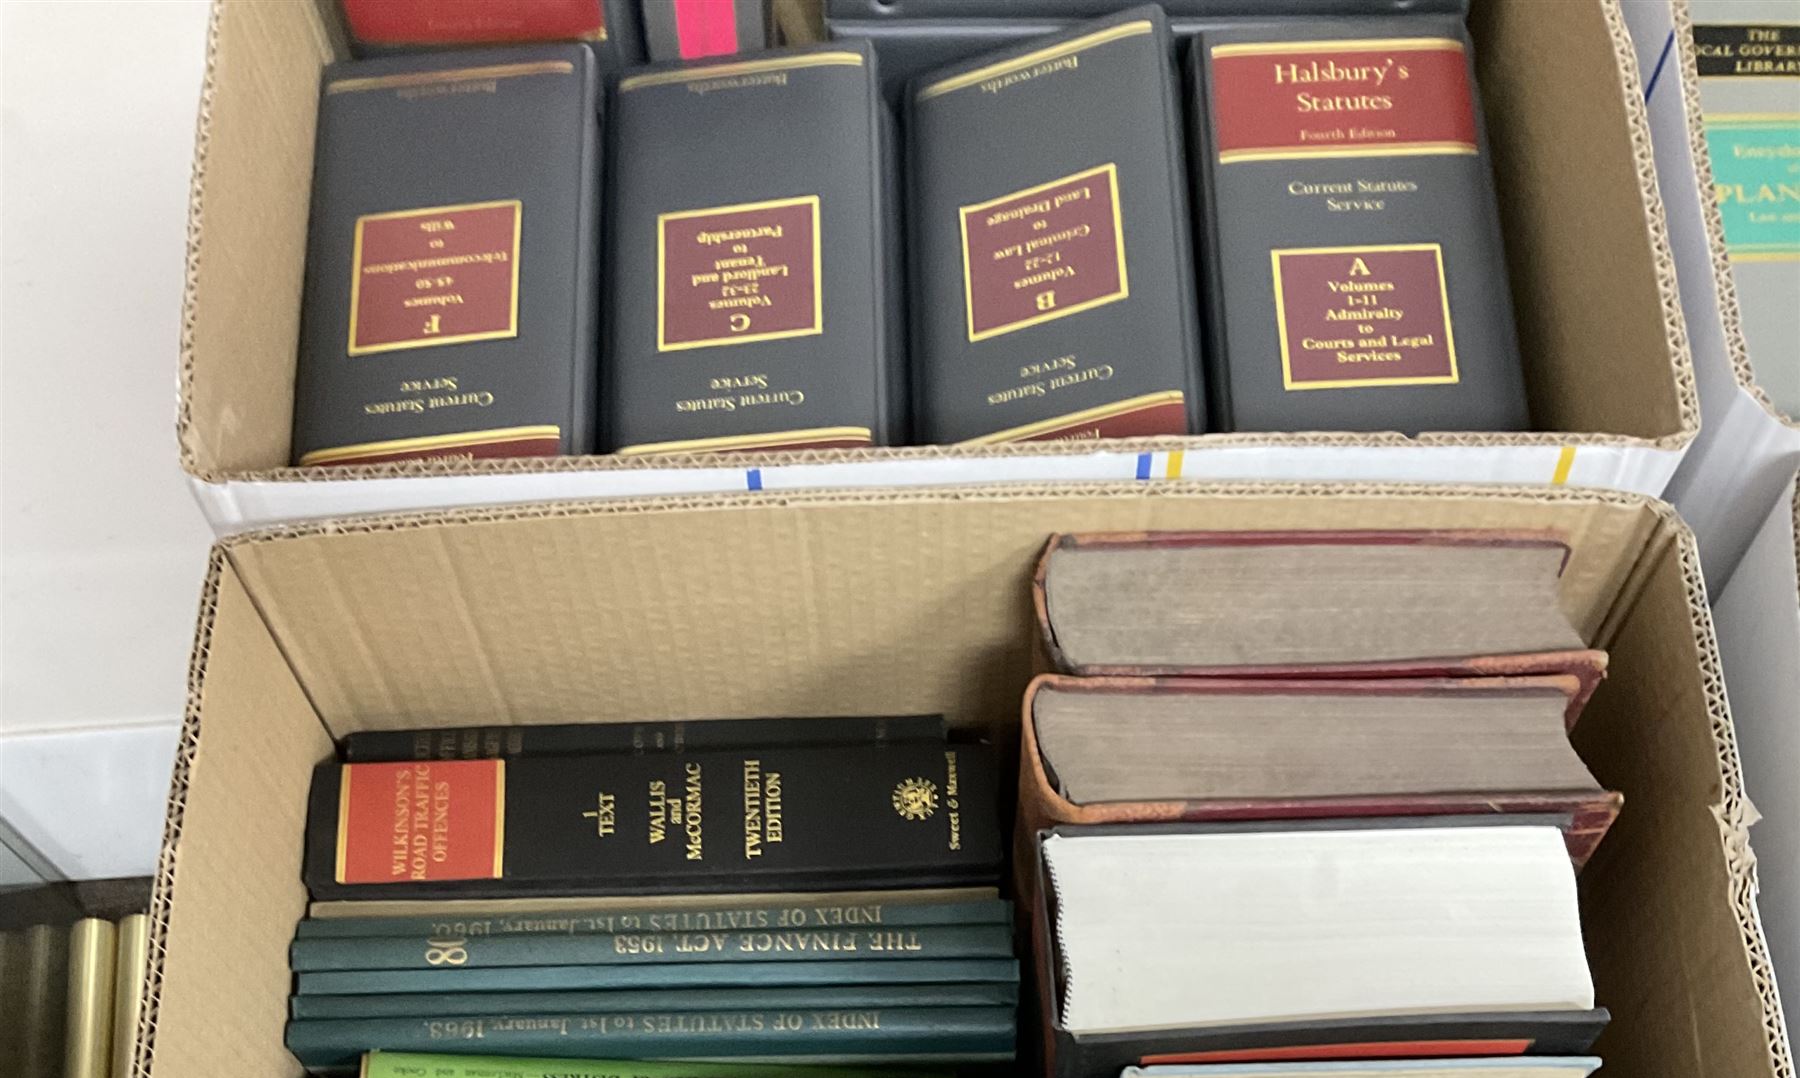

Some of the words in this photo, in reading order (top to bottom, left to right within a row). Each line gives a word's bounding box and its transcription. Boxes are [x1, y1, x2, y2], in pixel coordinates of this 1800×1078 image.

[1739, 44, 1800, 57] GOVER
[1274, 58, 1410, 83] Halsbury's
[1296, 91, 1393, 113] Statutes
[1300, 128, 1343, 142] Fourth
[1348, 126, 1396, 140] Edition
[1288, 180, 1352, 196] Current
[1357, 178, 1417, 194] Statutes
[1052, 186, 1092, 210] Land
[1327, 197, 1386, 213] Service
[986, 199, 1049, 227] Drainage
[696, 224, 783, 245] Partnership
[1032, 220, 1048, 231] to
[1026, 223, 1091, 251] Criminal
[732, 243, 748, 254] to
[993, 246, 1024, 261] Law
[363, 250, 508, 277] Telecommunications
[715, 254, 766, 271] Tenant
[1348, 257, 1372, 277] A
[691, 273, 719, 288] and
[721, 264, 789, 287] Landlord
[1013, 265, 1076, 289] Volumes
[1327, 279, 1395, 294] Volumes
[404, 293, 464, 309] Volumes
[708, 295, 772, 311] Volumes
[1036, 289, 1056, 310] B
[423, 314, 441, 335] F
[730, 314, 751, 332] C
[1324, 307, 1405, 323] Admiralty
[1357, 322, 1375, 335] to
[1302, 336, 1354, 350] Courts
[1357, 335, 1388, 349] and
[1390, 334, 1434, 350] Legal
[1019, 354, 1076, 378] Service
[1336, 349, 1402, 364] Services
[400, 377, 458, 393] Service
[710, 374, 768, 390] Service
[1049, 364, 1114, 394] Current
[428, 391, 494, 411] Current
[740, 389, 805, 409] Current
[987, 382, 1047, 406] Statutes
[365, 398, 425, 415] Statutes
[675, 397, 736, 415] Statutes
[414, 764, 431, 832] TRAFFIC
[766, 772, 783, 843] EDITION
[598, 792, 615, 838] TEXT
[649, 779, 667, 844] WALLIS
[666, 799, 682, 825] and
[686, 762, 703, 861] McCORMAC
[744, 759, 762, 860] TWENTIETH
[392, 769, 412, 876] WILKINSON'S
[433, 781, 450, 863] OFFENCES
[948, 811, 961, 850] Sweet
[412, 836, 428, 880] ROAD
[621, 915, 641, 929] to
[650, 910, 768, 932] STATUTES
[778, 907, 806, 927] OF
[815, 905, 882, 924] INDEX
[614, 935, 664, 954] 1953
[740, 933, 857, 952] FINANCE
[870, 932, 922, 952] THE
[615, 1019, 634, 1030] to
[644, 1015, 764, 1034] STATUTES
[774, 1015, 803, 1030] OF
[813, 1012, 879, 1030] INDEX
